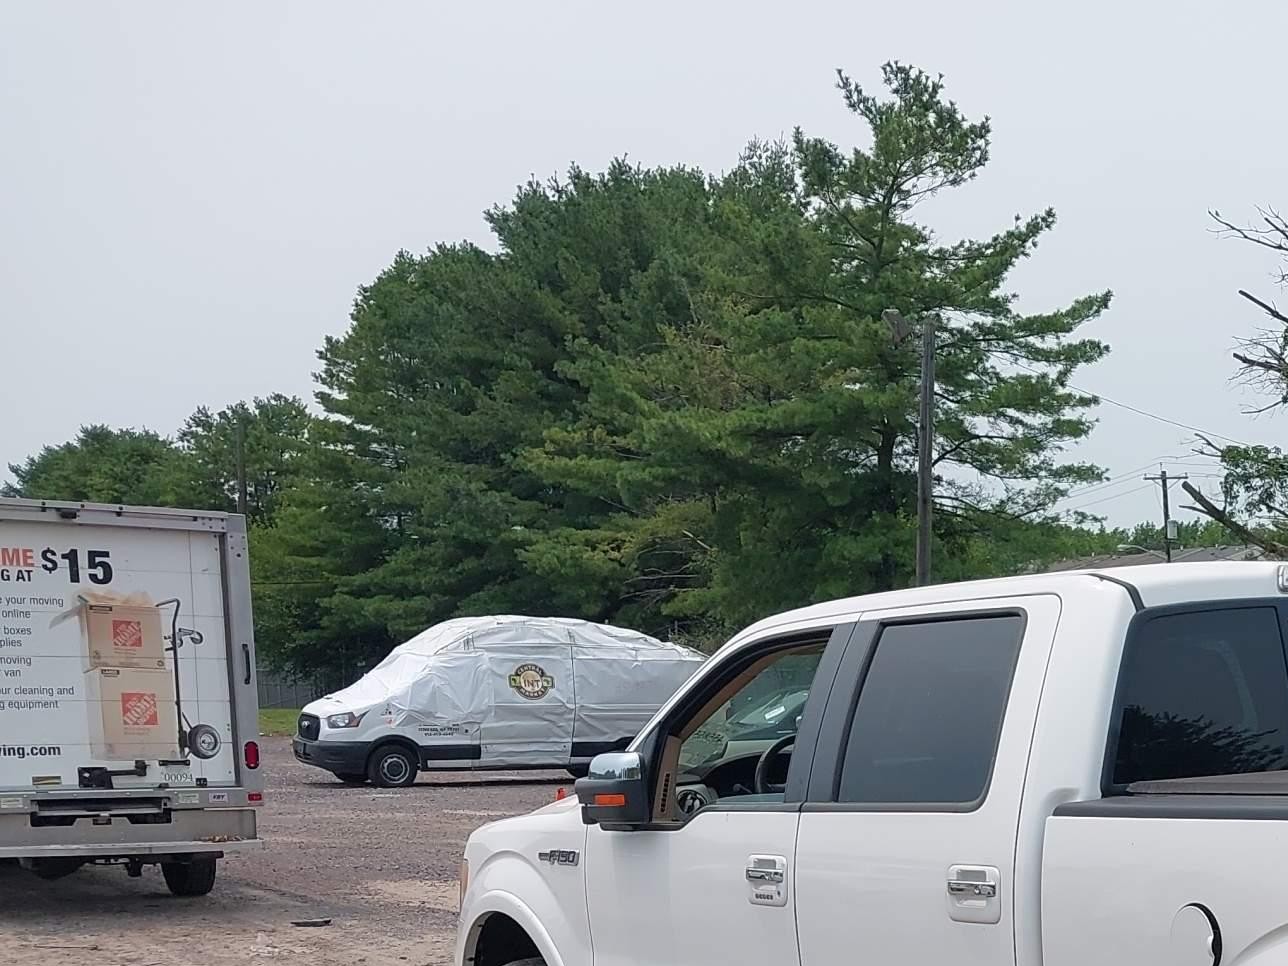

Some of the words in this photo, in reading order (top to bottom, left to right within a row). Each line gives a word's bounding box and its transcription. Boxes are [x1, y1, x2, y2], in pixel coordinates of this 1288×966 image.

[41, 547, 113, 585] $15
[16, 569, 33, 582] AT
[6, 596, 26, 606] your
[29, 596, 64, 607] moving
[2, 609, 31, 619] online
[3, 625, 32, 635] boxes
[4, 668, 21, 677] van
[523, 679, 540, 689] INT
[14, 686, 54, 696] cleaning
[56, 686, 75, 695] and
[8, 700, 59, 710] equipment
